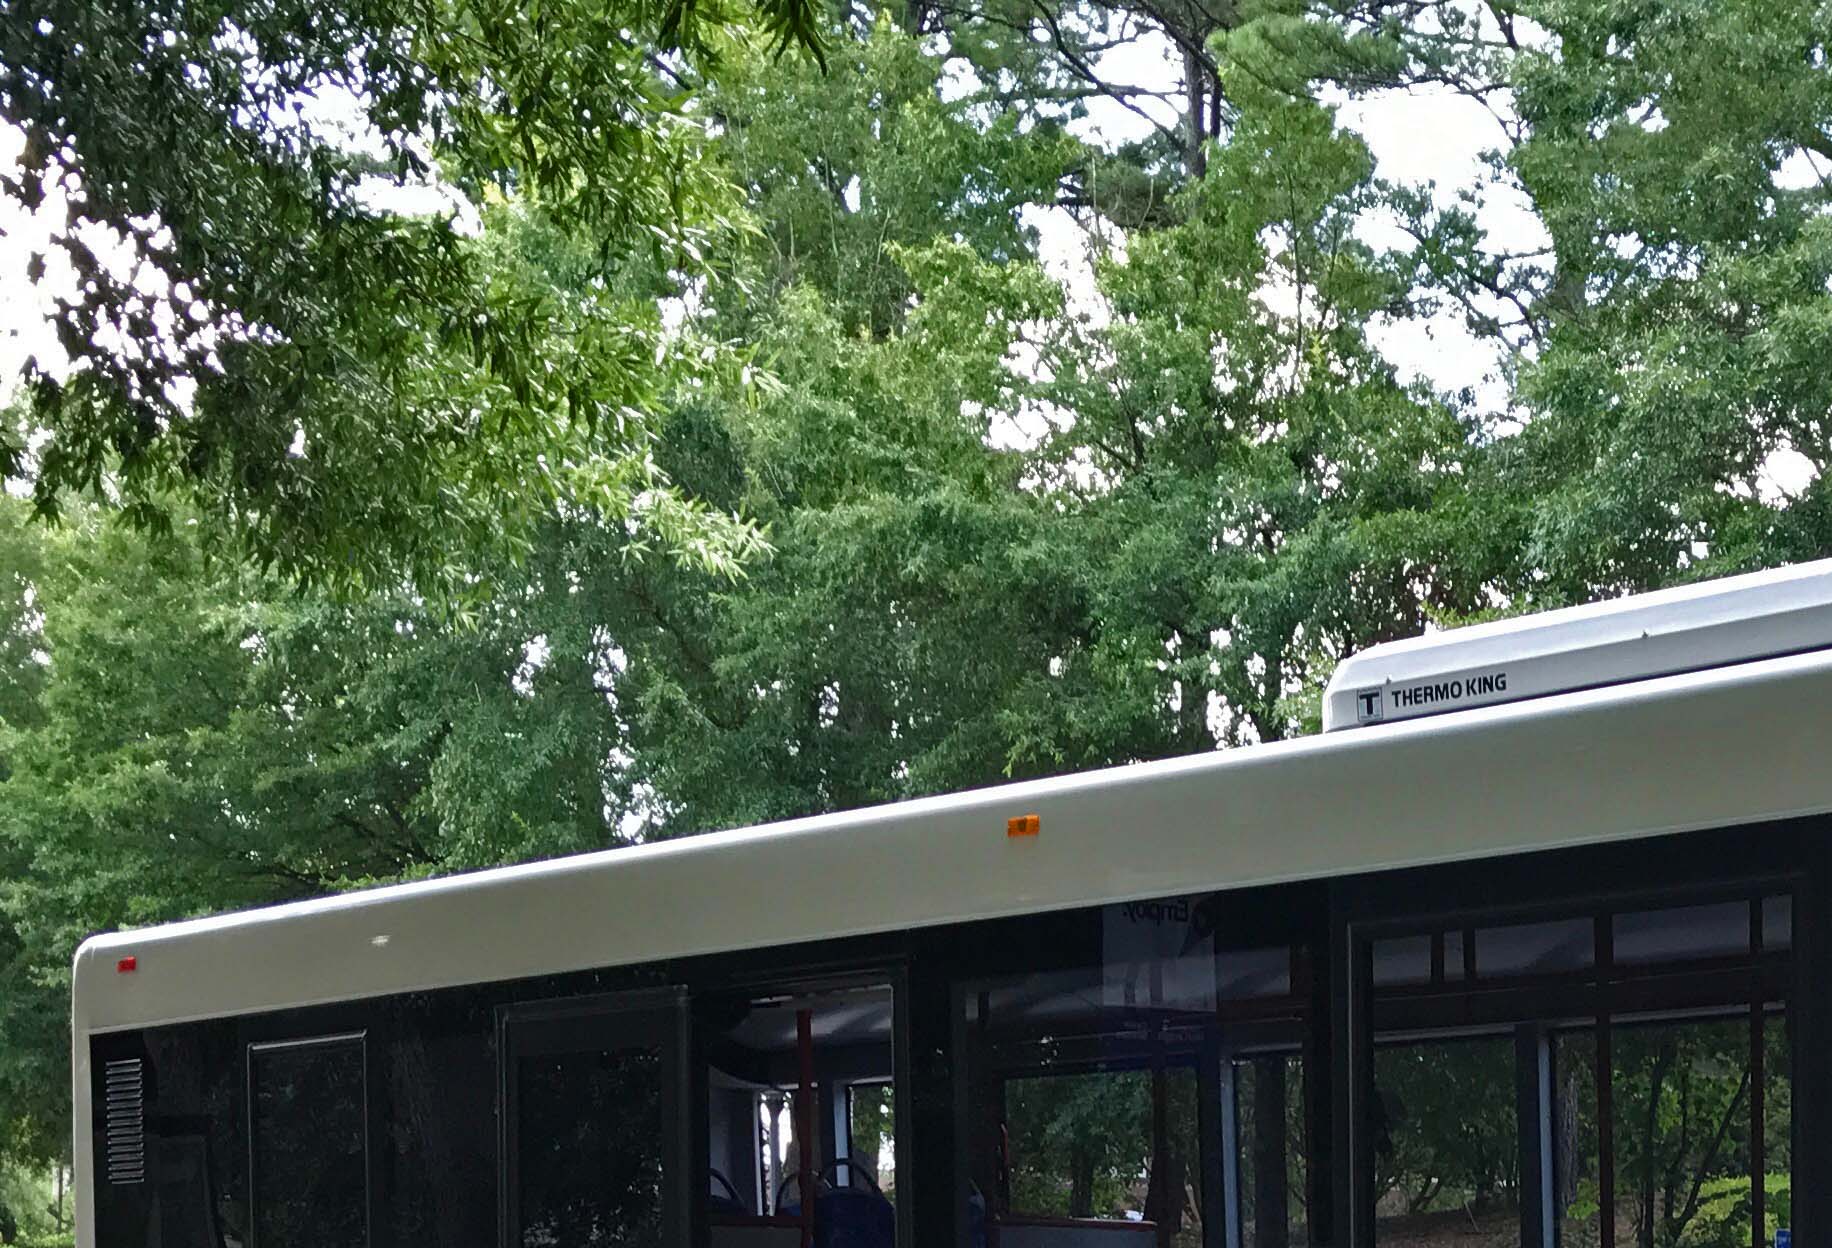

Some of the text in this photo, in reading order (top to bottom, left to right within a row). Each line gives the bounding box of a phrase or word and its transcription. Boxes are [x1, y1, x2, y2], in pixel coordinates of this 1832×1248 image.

[1359, 692, 1380, 715] T
[1391, 673, 1507, 708] THERMO KING
